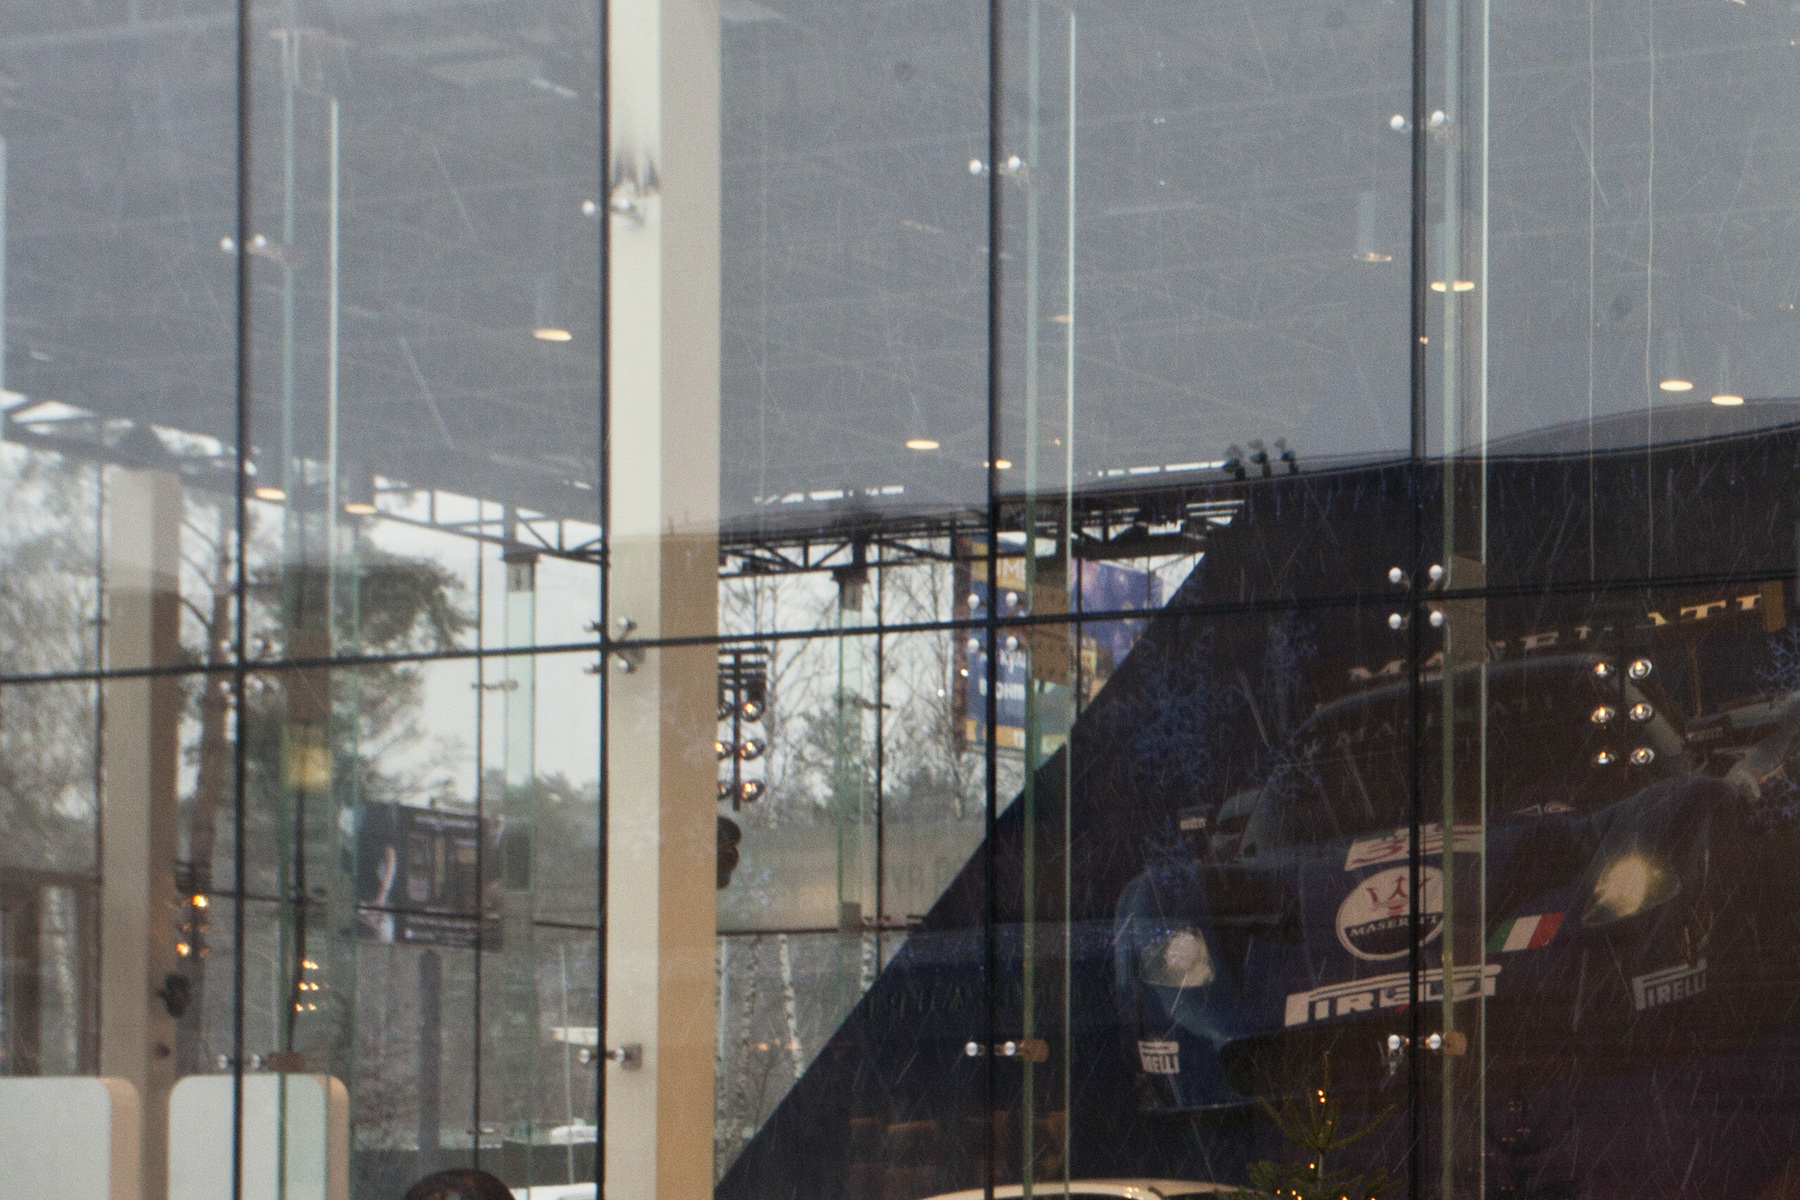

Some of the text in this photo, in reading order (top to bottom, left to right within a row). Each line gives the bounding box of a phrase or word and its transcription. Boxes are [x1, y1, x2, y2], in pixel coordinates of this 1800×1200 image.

[1347, 592, 1762, 682] MAEATI
[1350, 915, 1438, 938] MASERTI
[1632, 959, 1707, 1011] PIRELLI
